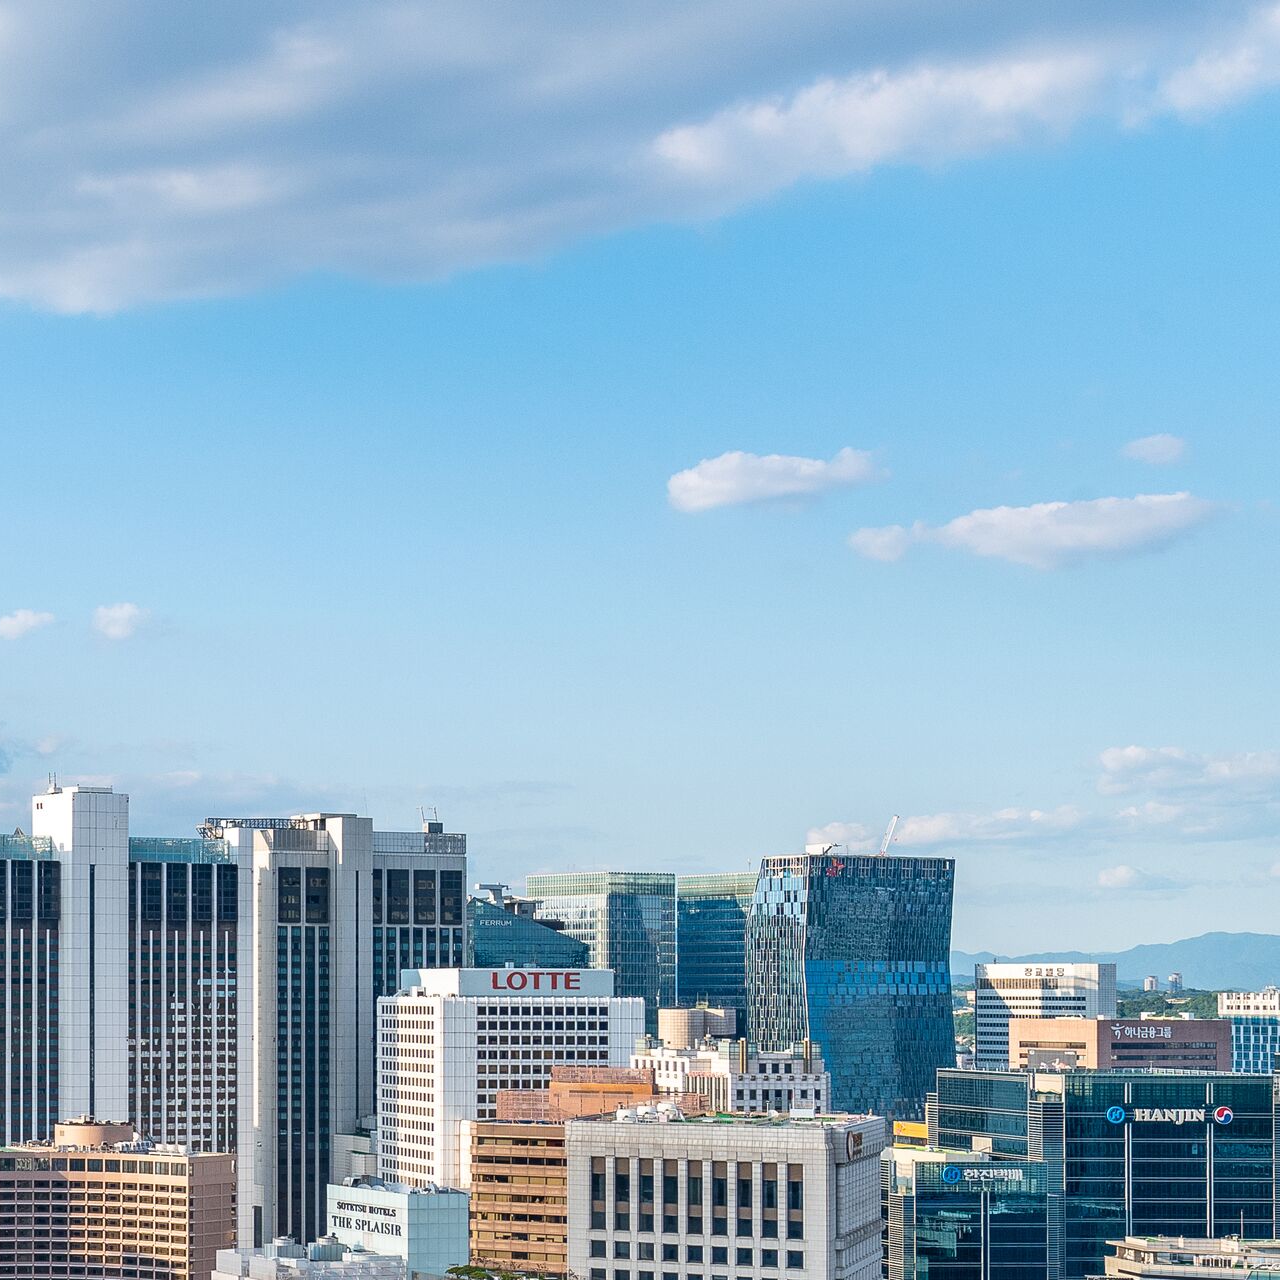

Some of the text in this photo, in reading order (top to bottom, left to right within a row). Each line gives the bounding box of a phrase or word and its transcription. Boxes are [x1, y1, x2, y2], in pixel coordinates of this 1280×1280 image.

[492, 972, 580, 990] LOTTE
[1125, 1026, 1171, 1038] 하나금융그룹
[1134, 1108, 1206, 1125] HANJIN
[963, 1167, 1024, 1181] 한진택배
[337, 1201, 396, 1217] SOTETSU HOTELS
[332, 1215, 402, 1236] THE SPLAISIR
